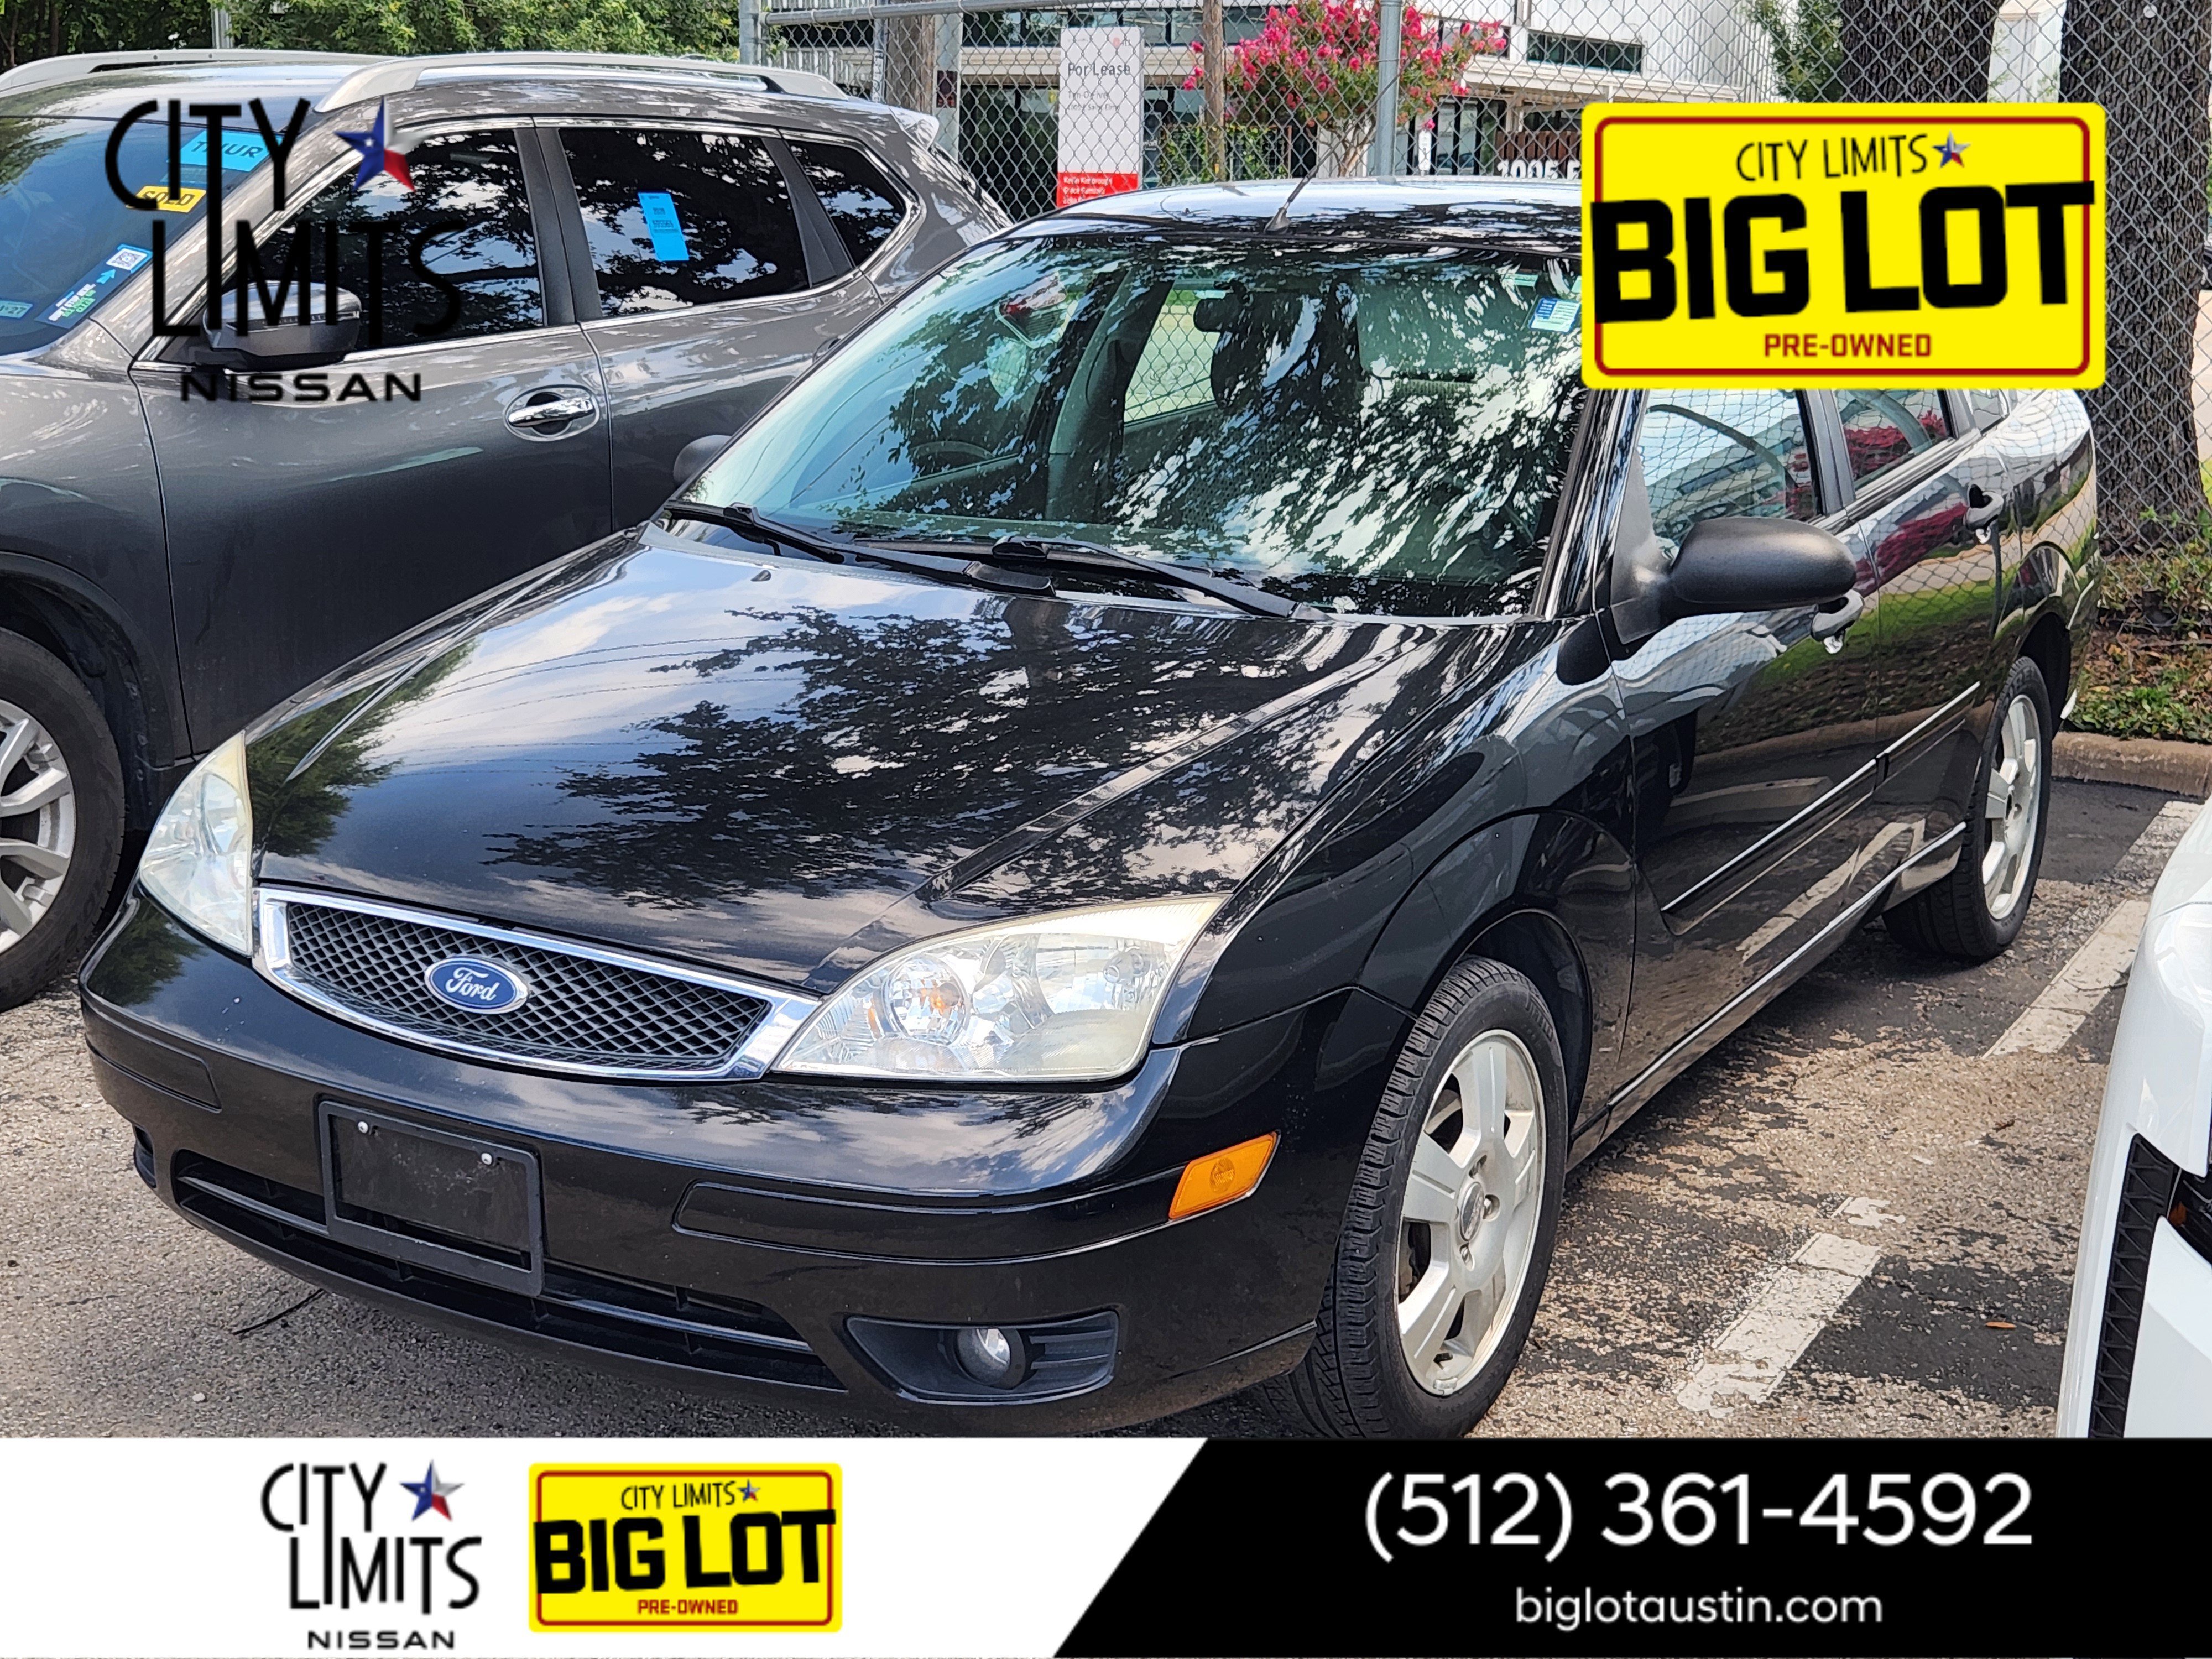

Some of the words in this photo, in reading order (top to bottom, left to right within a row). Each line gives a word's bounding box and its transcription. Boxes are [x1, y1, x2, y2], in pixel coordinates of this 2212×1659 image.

[1068, 62, 1089, 76] For
[1093, 61, 1130, 76] Lease
[1496, 158, 1559, 179] 1005
[445, 967, 500, 1001] Ford
